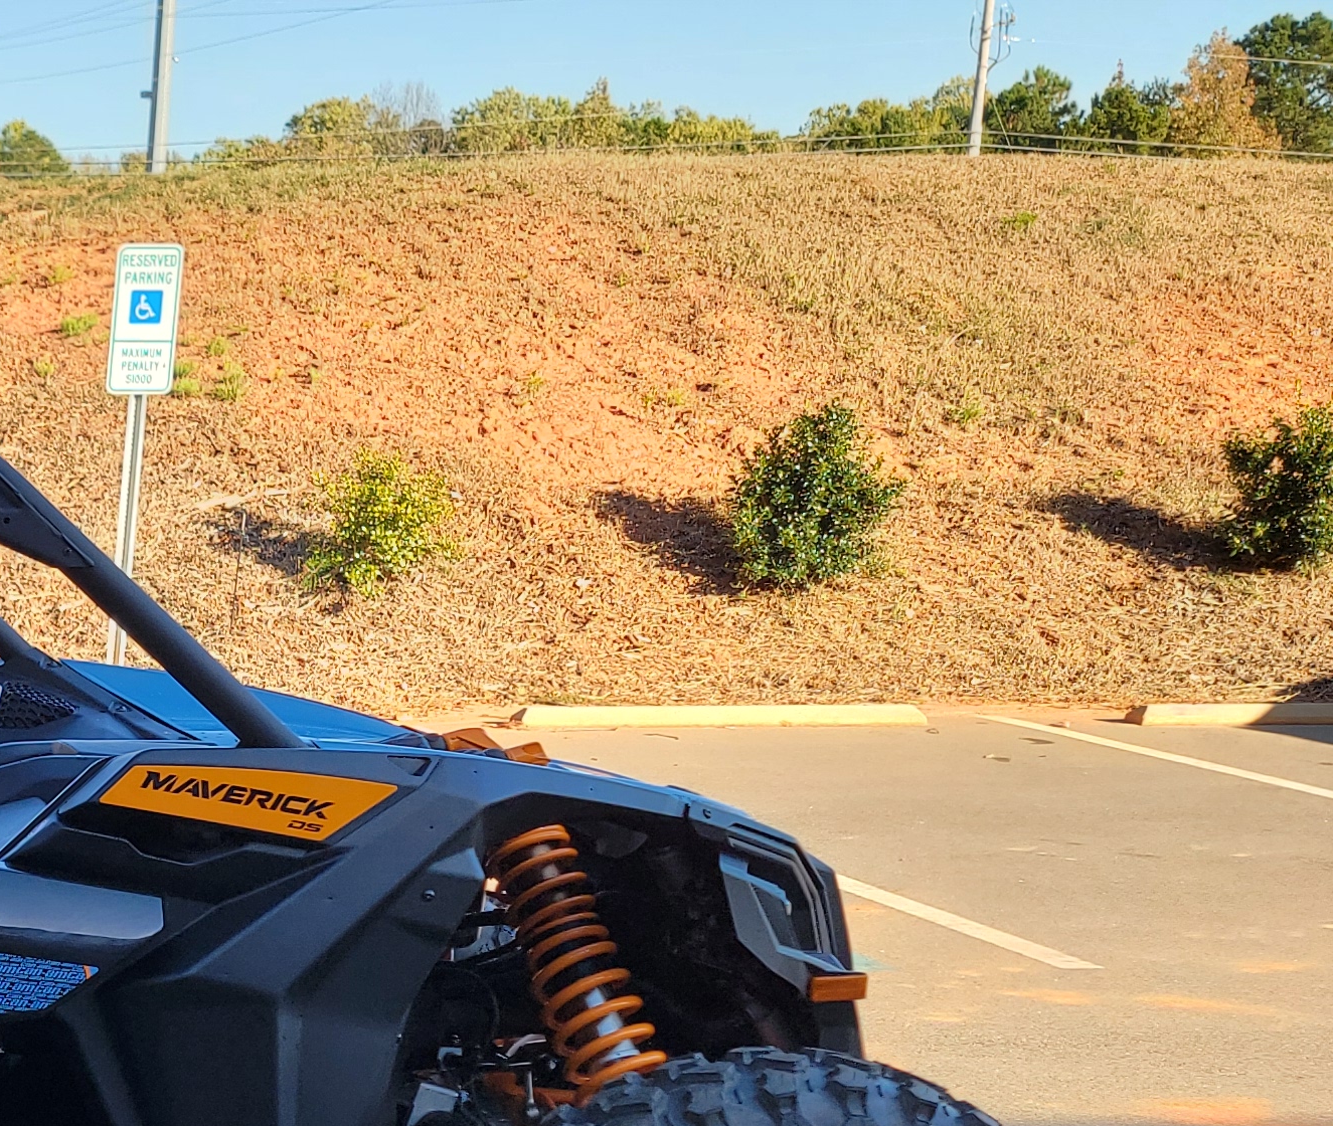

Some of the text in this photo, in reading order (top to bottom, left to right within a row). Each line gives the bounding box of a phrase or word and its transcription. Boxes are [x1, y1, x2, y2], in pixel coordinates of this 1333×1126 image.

[122, 254, 177, 267] RESERVED
[124, 272, 173, 285] PARKING
[121, 348, 162, 358] MAXIMUM
[121, 361, 159, 371] PENALTY
[139, 770, 335, 820] MAVERICK
[287, 820, 323, 833] DS
